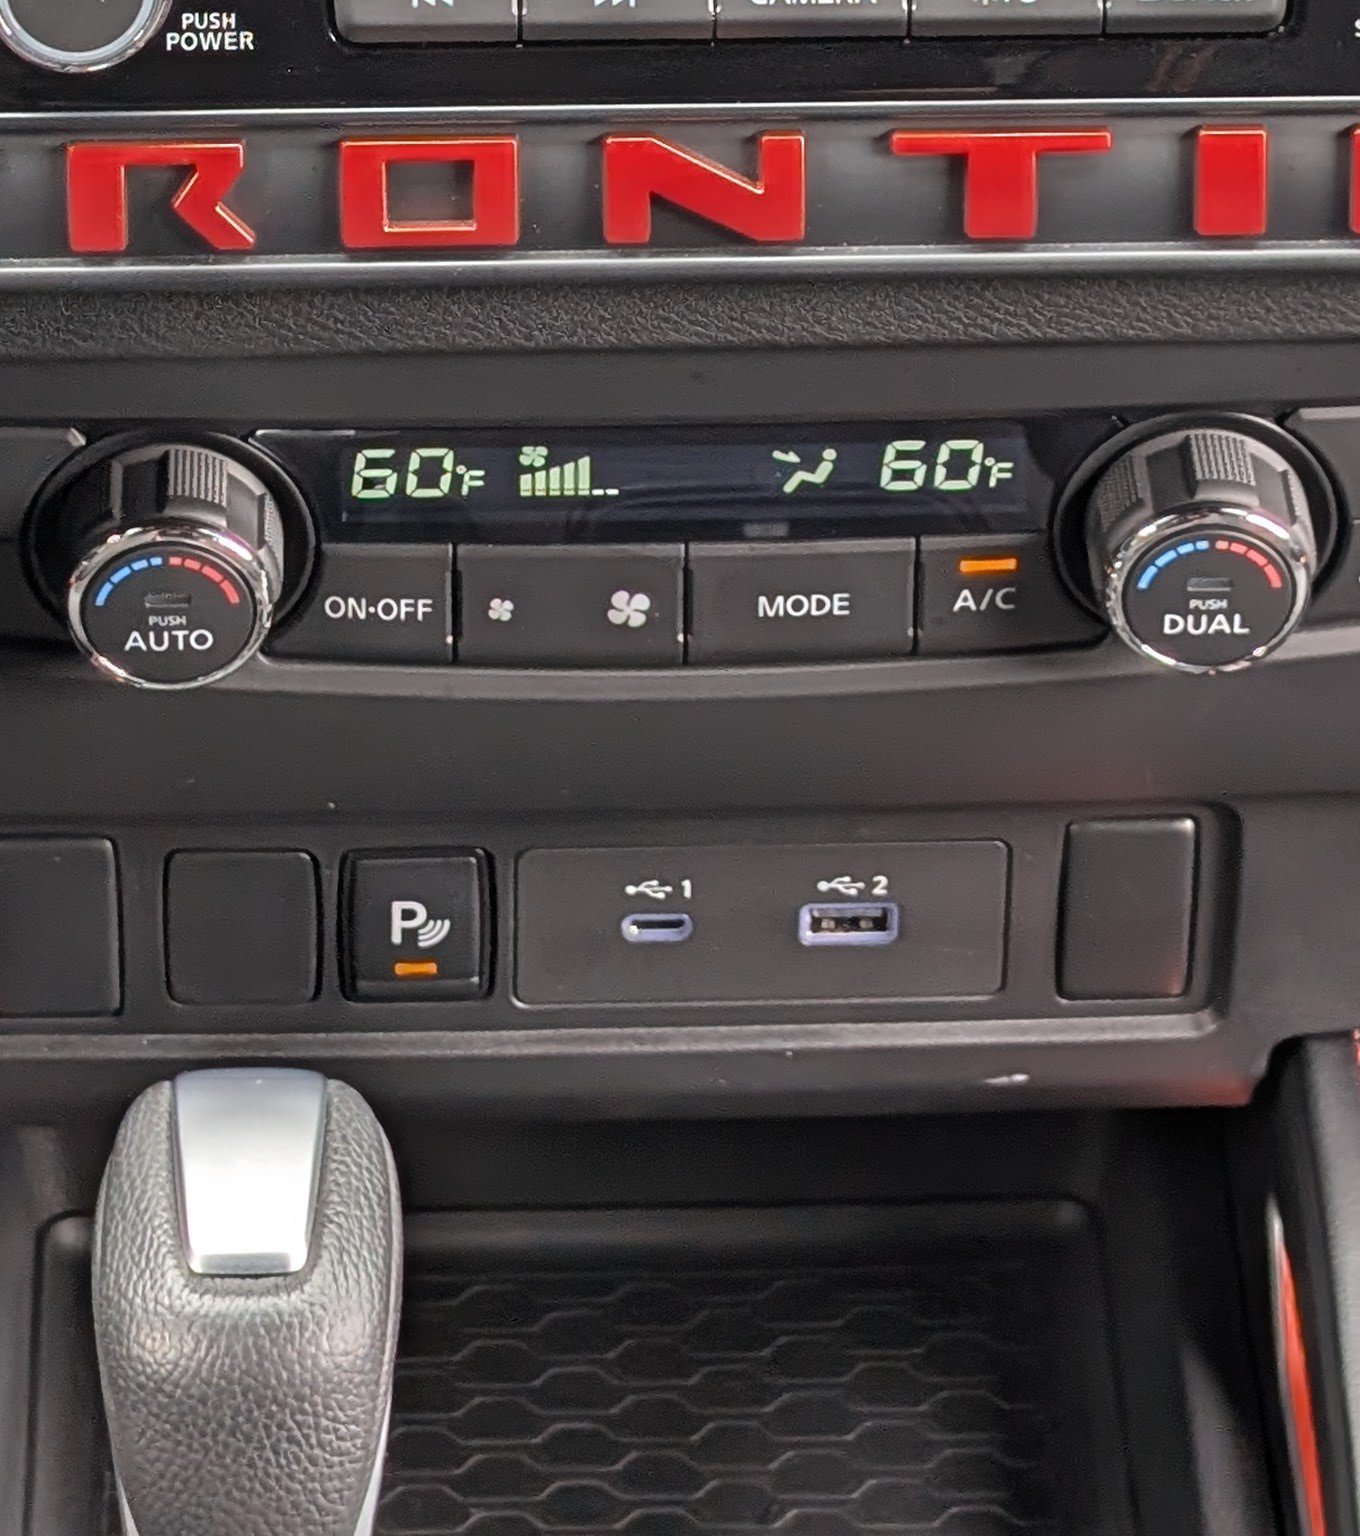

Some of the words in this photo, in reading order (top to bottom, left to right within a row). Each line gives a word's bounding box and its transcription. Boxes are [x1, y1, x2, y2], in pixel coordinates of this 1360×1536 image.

[181, 12, 237, 31] PUSH
[165, 32, 255, 52] POWER
[757, 593, 851, 618] MODE
[953, 588, 1017, 612] A/C
[1188, 599, 1228, 611] PUSH
[147, 615, 188, 627] PUSH
[1162, 613, 1250, 637] DUAL
[123, 628, 215, 653] AUTO
[681, 879, 692, 899] 1
[871, 876, 889, 895] 2
[389, 901, 426, 948] P
